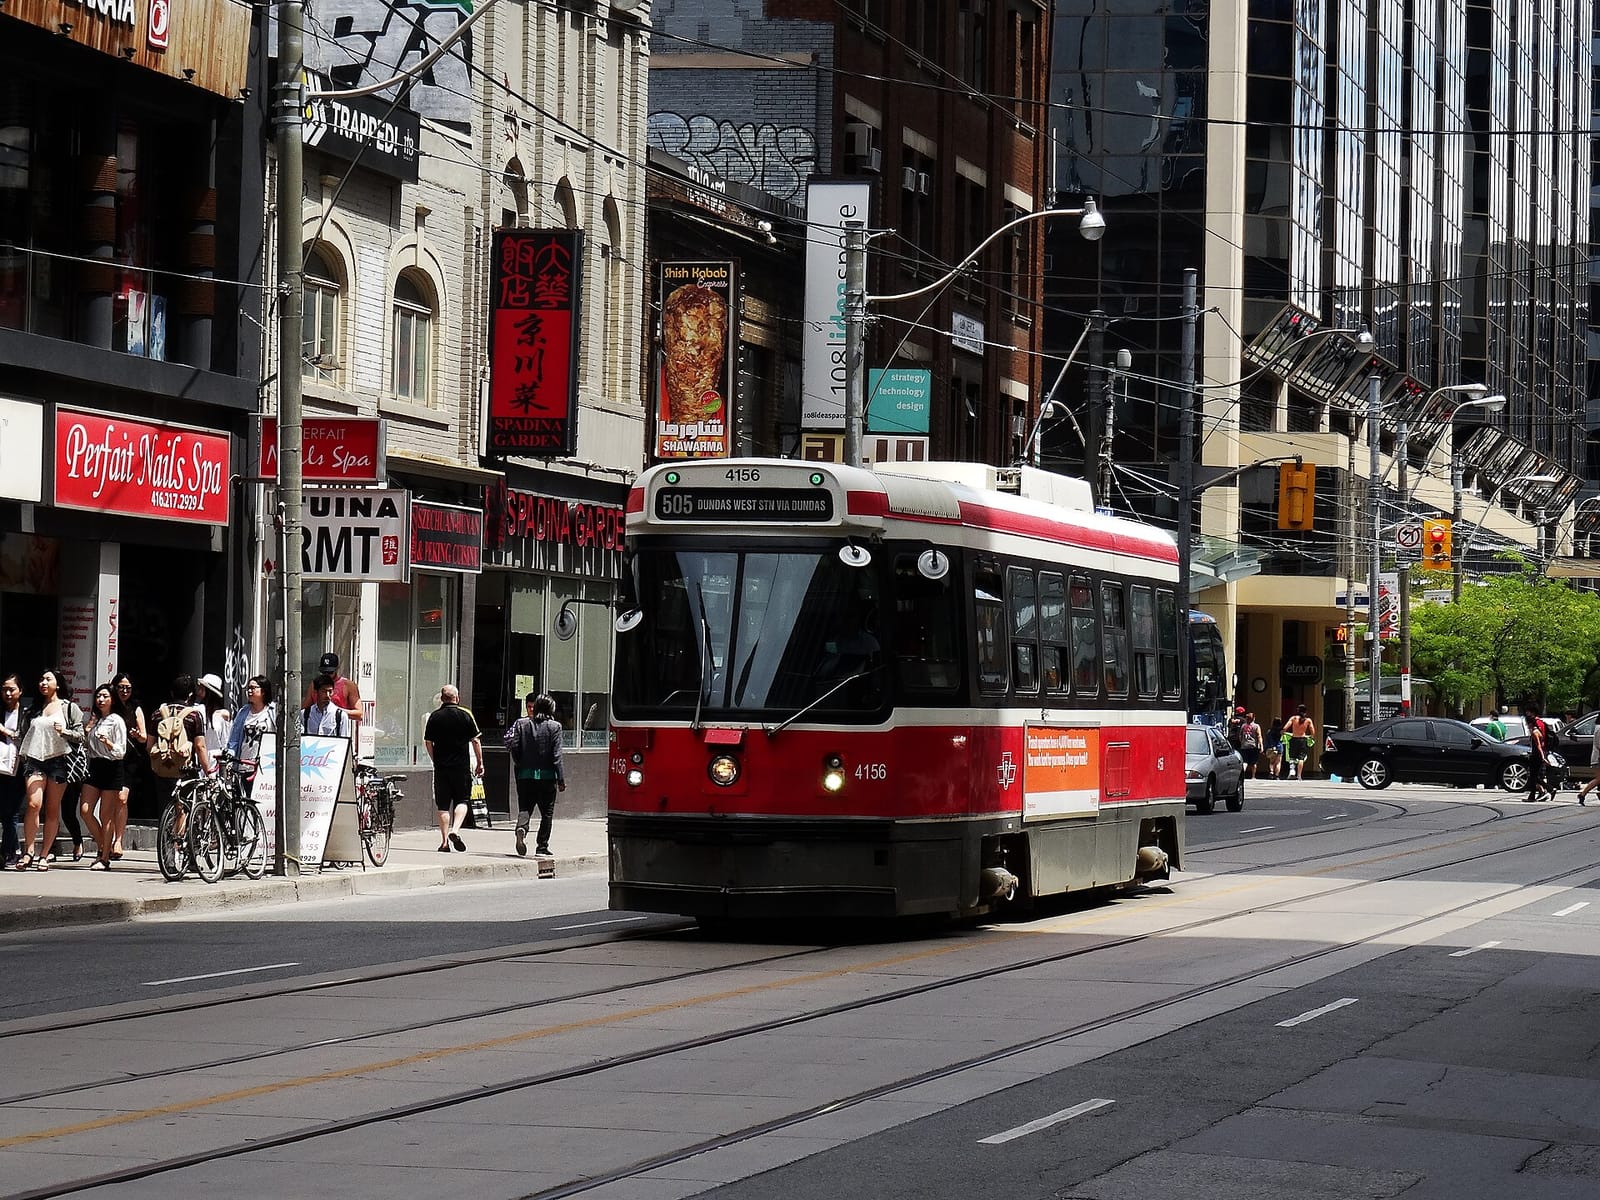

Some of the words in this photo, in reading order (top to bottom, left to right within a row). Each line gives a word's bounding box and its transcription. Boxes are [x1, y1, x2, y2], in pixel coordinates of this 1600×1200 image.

[332, 101, 398, 156] TRAPPED!
[664, 267, 689, 278] Shish
[691, 267, 728, 279] Kabab
[891, 374, 926, 383] strategy
[879, 387, 925, 398] technology
[896, 401, 924, 411] design
[494, 418, 562, 431] SPADINA
[660, 418, 724, 440] شاورما
[302, 428, 346, 440] ERFAIT
[494, 433, 560, 447] GARDEN
[662, 440, 724, 452] SHAWARMA
[332, 445, 371, 474] Spa
[66, 424, 135, 498] Perfait
[137, 433, 186, 490] Nails
[187, 441, 222, 511] Spa
[725, 469, 760, 482] 4156
[151, 491, 198, 511] 416.217.2929
[662, 494, 693, 514] 505
[697, 499, 732, 511] DUNDAS
[733, 499, 757, 511] WEST
[758, 500, 776, 511] STN
[776, 500, 790, 511] VIA
[791, 500, 826, 511] DUNDAS
[507, 490, 571, 544] SPADINA
[575, 503, 624, 552] GARDE
[363, 663, 372, 676] 122
[1286, 663, 1318, 673] atrium
[611, 758, 627, 774] 4156
[854, 764, 887, 780] 4156
